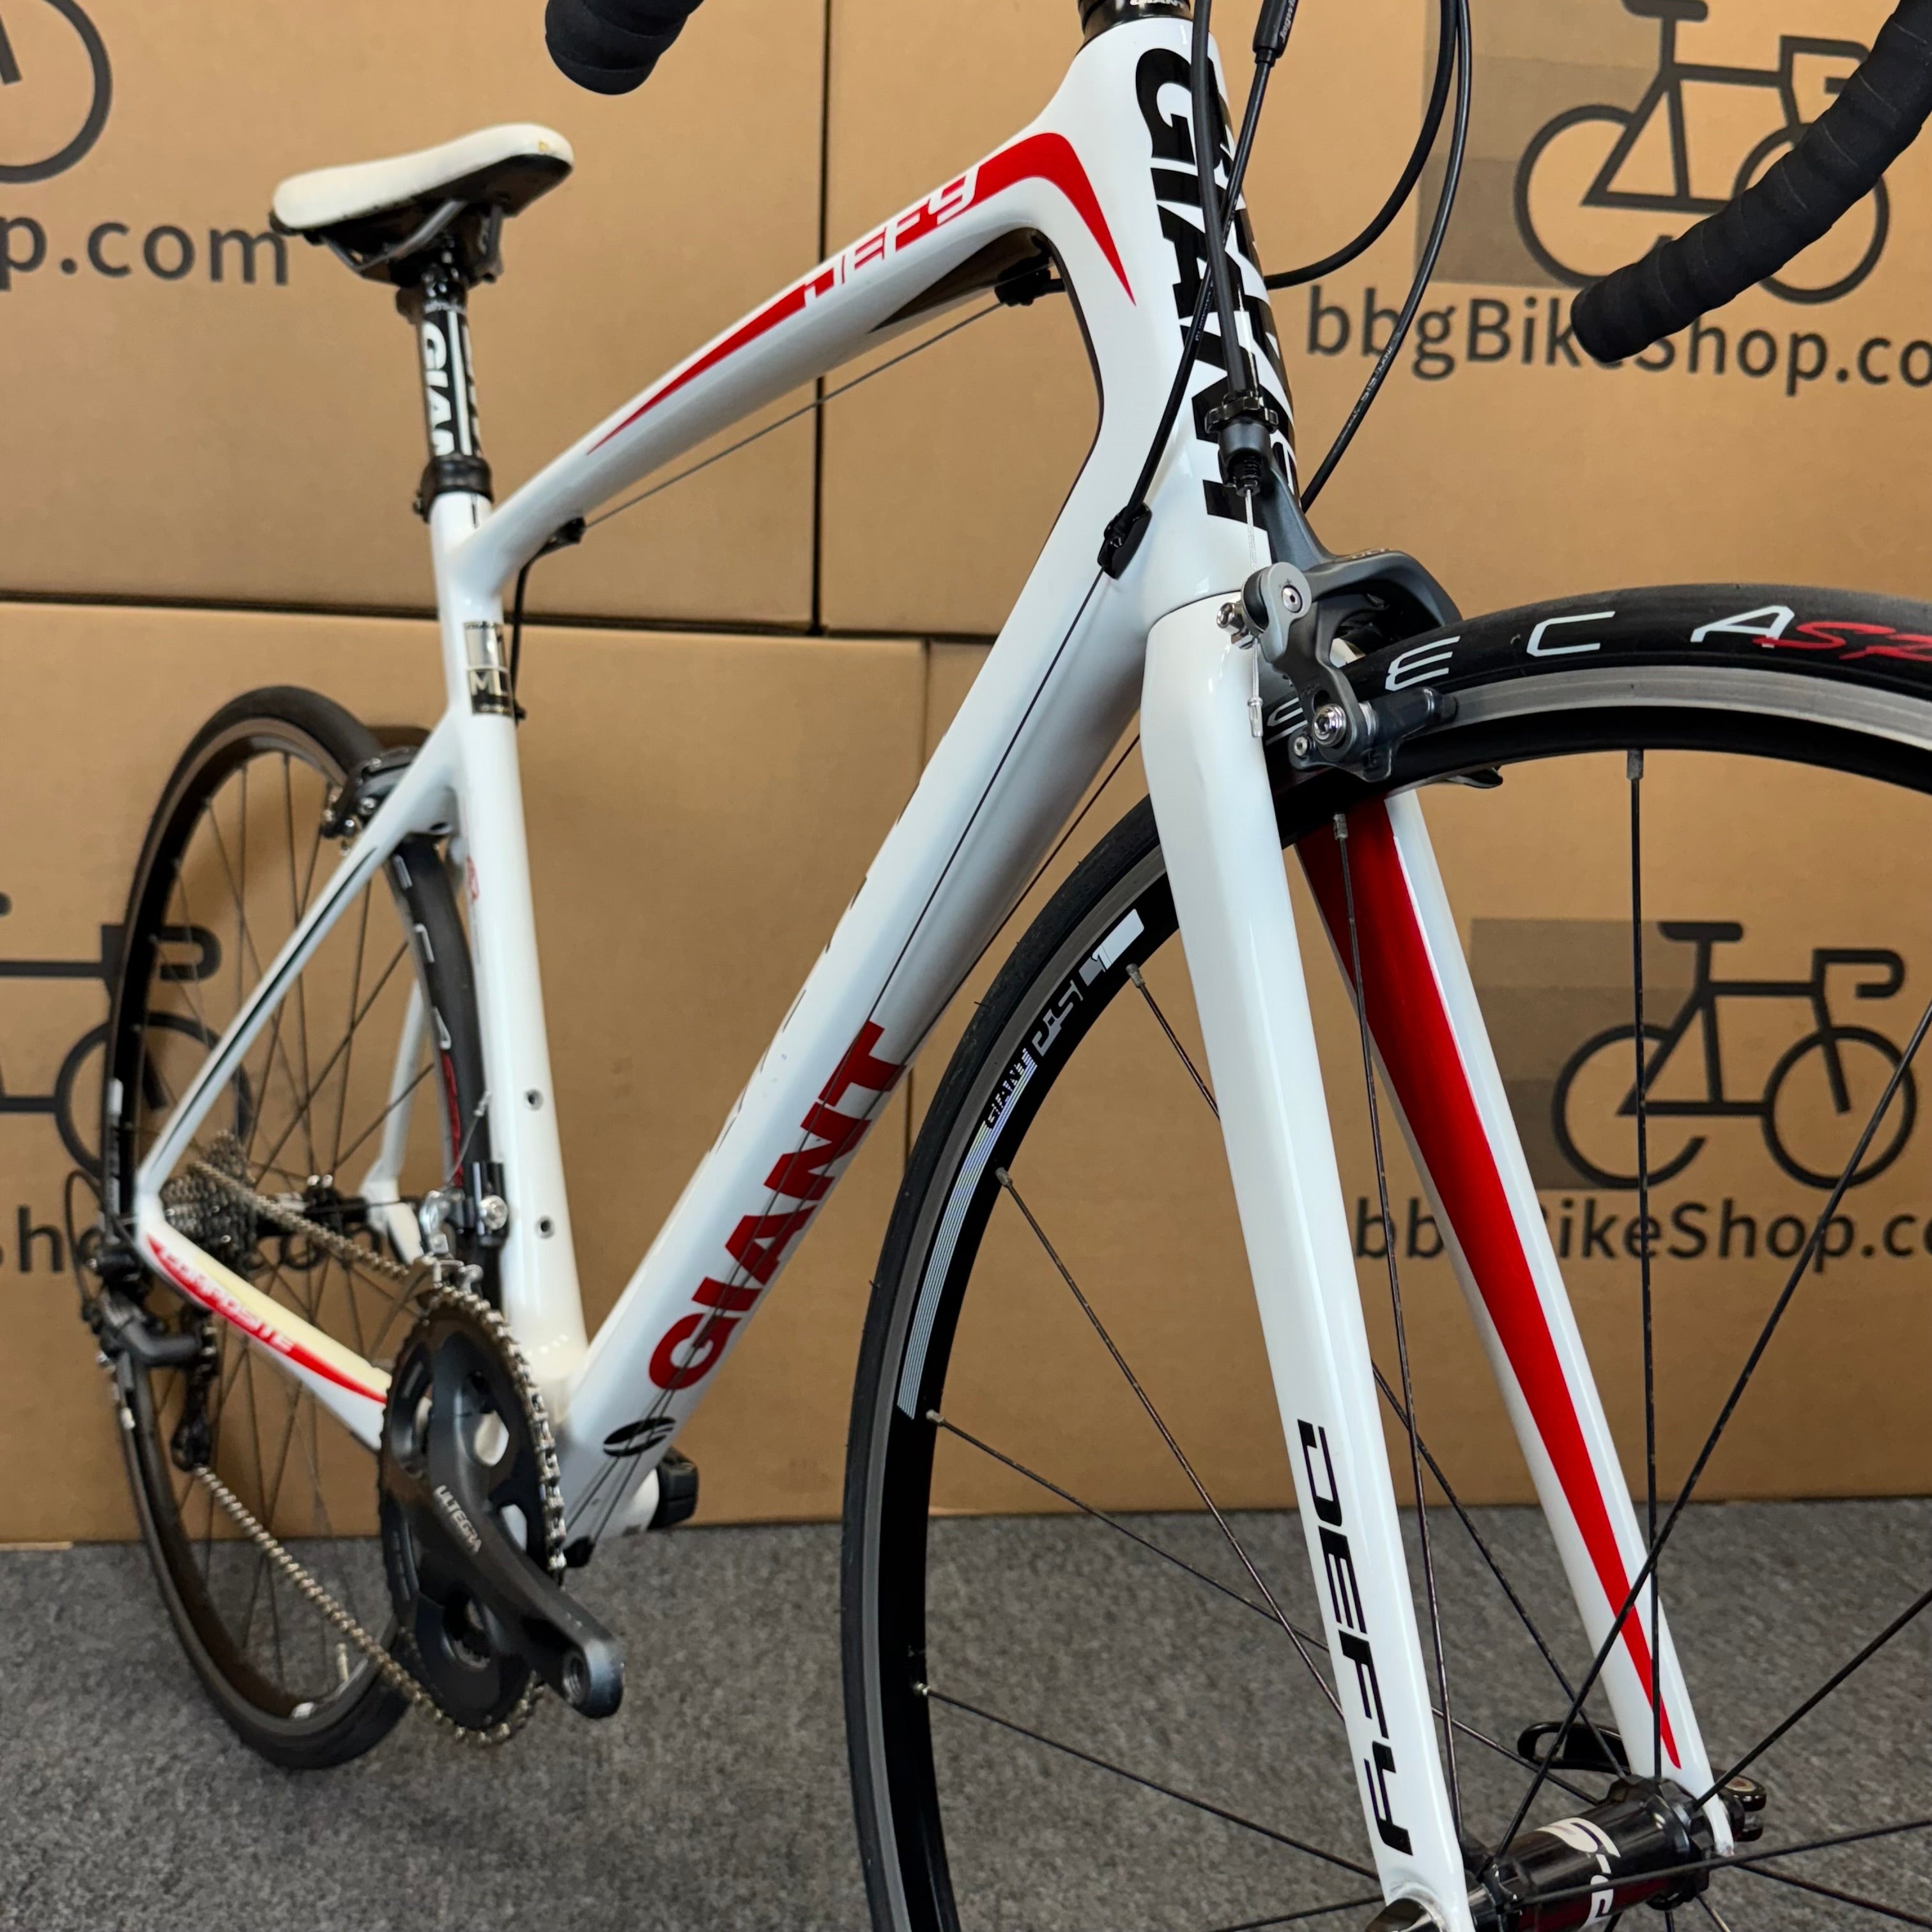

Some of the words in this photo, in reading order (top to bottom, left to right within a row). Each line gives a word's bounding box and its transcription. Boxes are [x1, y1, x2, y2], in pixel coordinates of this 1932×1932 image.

[649, 1020, 907, 1390] GIANT
[1356, 1197, 1932, 1274] bbikeShop.c
[434, 1484, 482, 1553] ULTEGRA
[1298, 1419, 1413, 1856] DEFY
